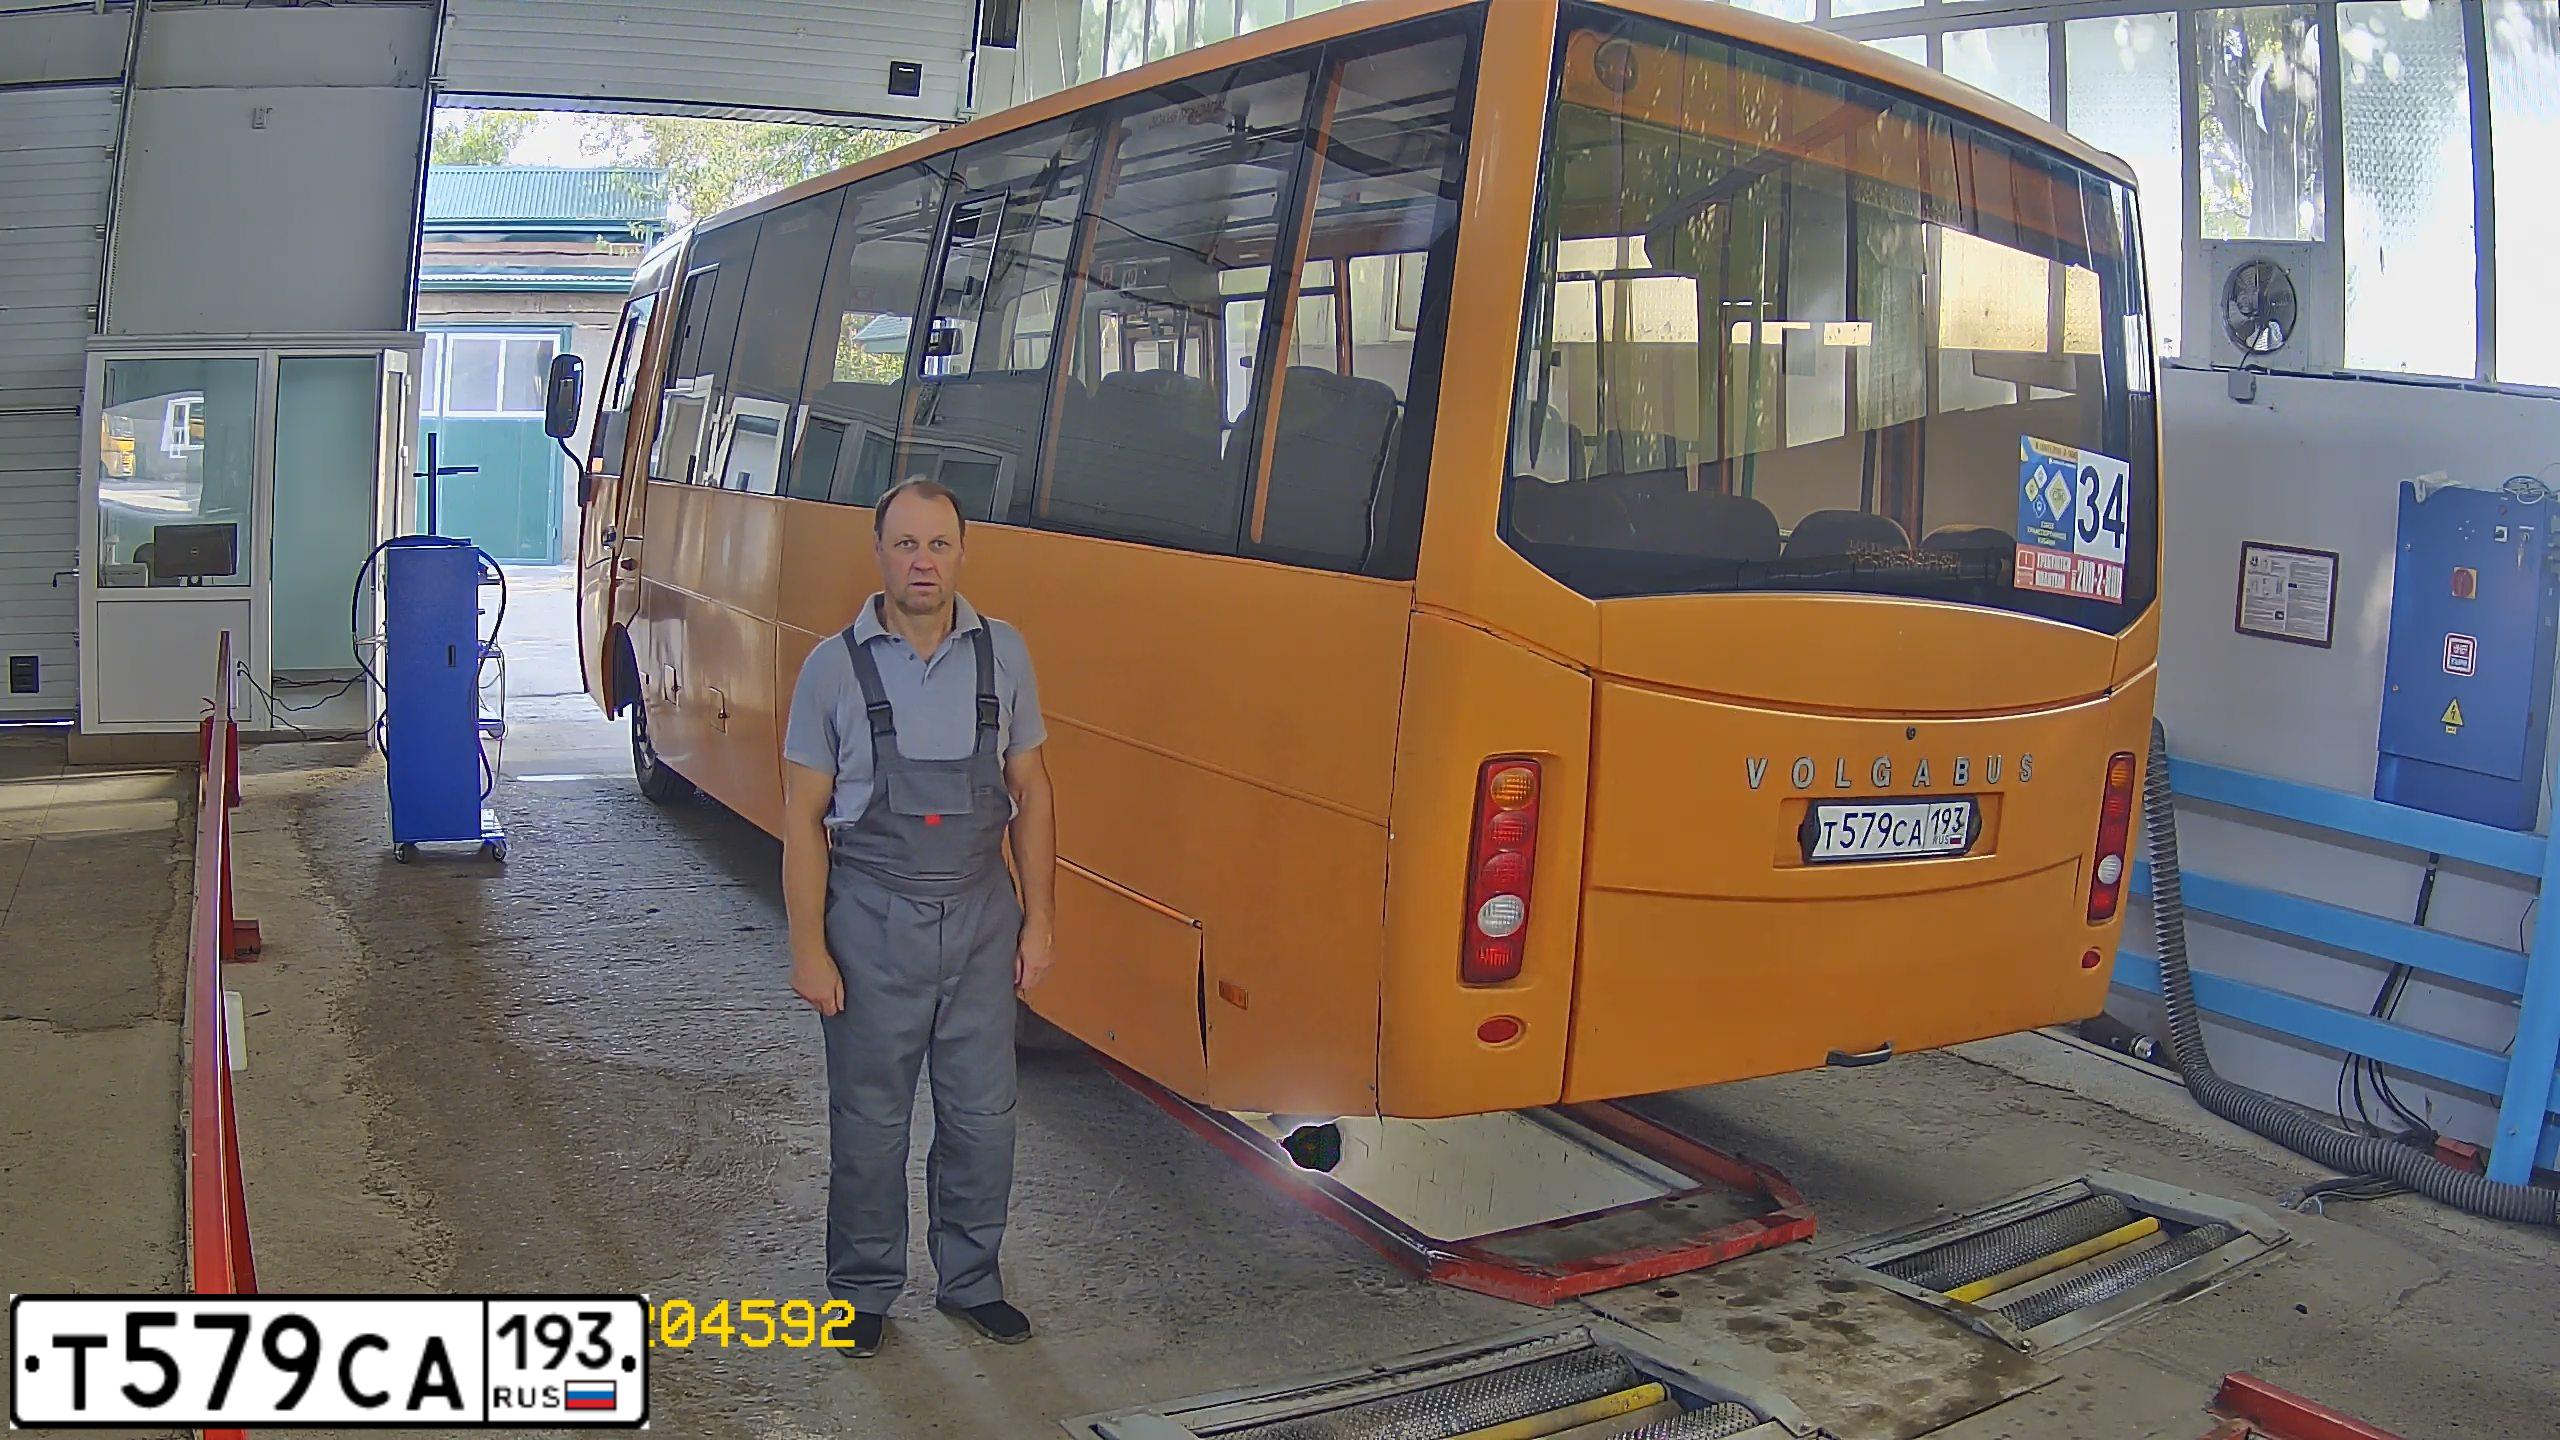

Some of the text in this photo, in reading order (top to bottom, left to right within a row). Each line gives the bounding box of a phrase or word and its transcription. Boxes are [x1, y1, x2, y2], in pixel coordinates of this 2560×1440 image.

[2077, 465, 2126, 549] 34
[1745, 753, 2034, 789] VOLGABUS
[1823, 807, 1965, 850] Т579СА 193
[1932, 834, 1949, 846] RUS
